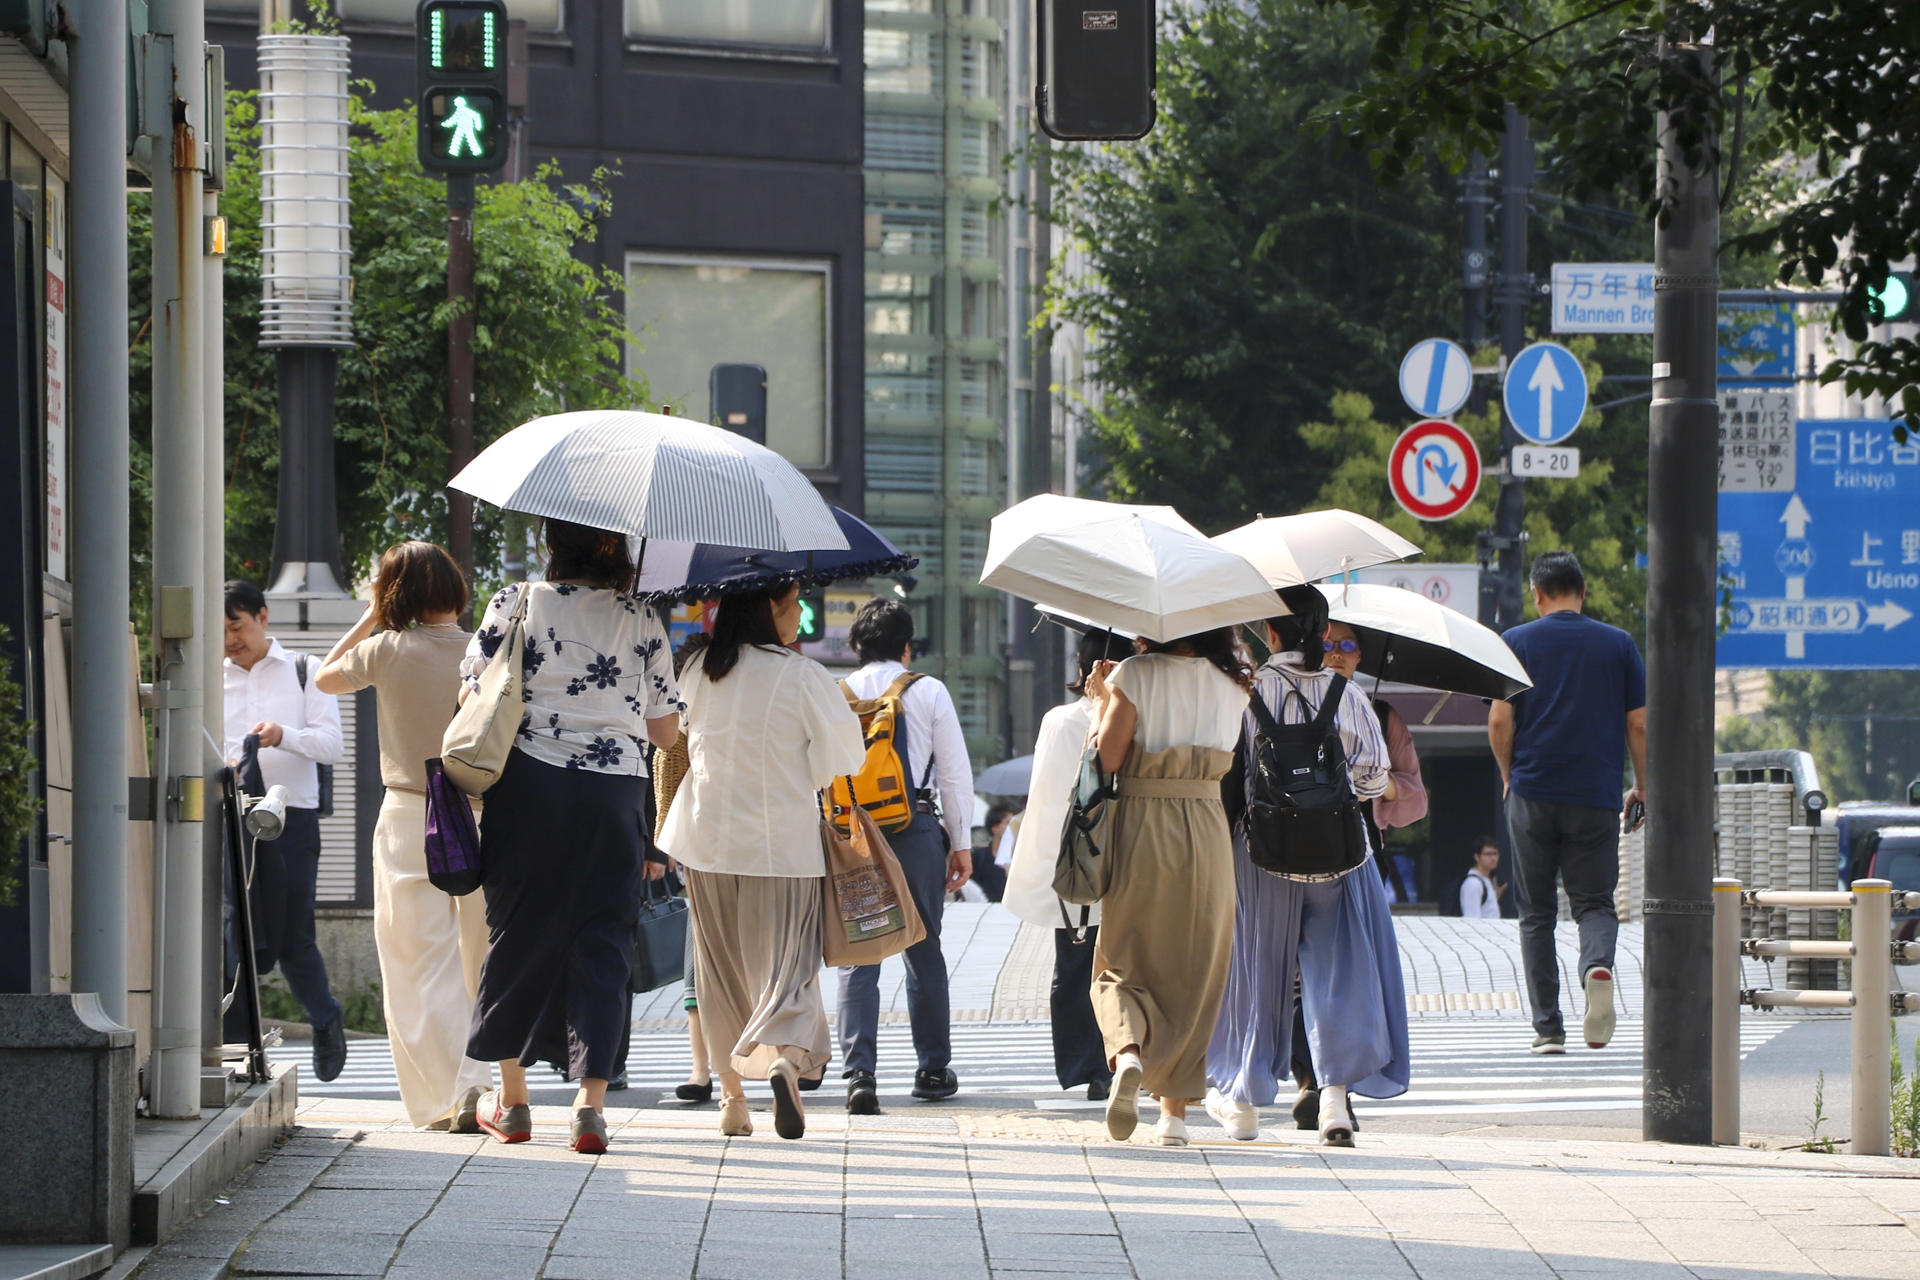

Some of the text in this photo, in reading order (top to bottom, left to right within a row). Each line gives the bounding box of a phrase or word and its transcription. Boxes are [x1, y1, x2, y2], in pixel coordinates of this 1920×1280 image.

[1564, 304, 1624, 322] Mannen
[1866, 570, 1919, 589] Ueno
[1760, 605, 1850, 626] 昭和通り
